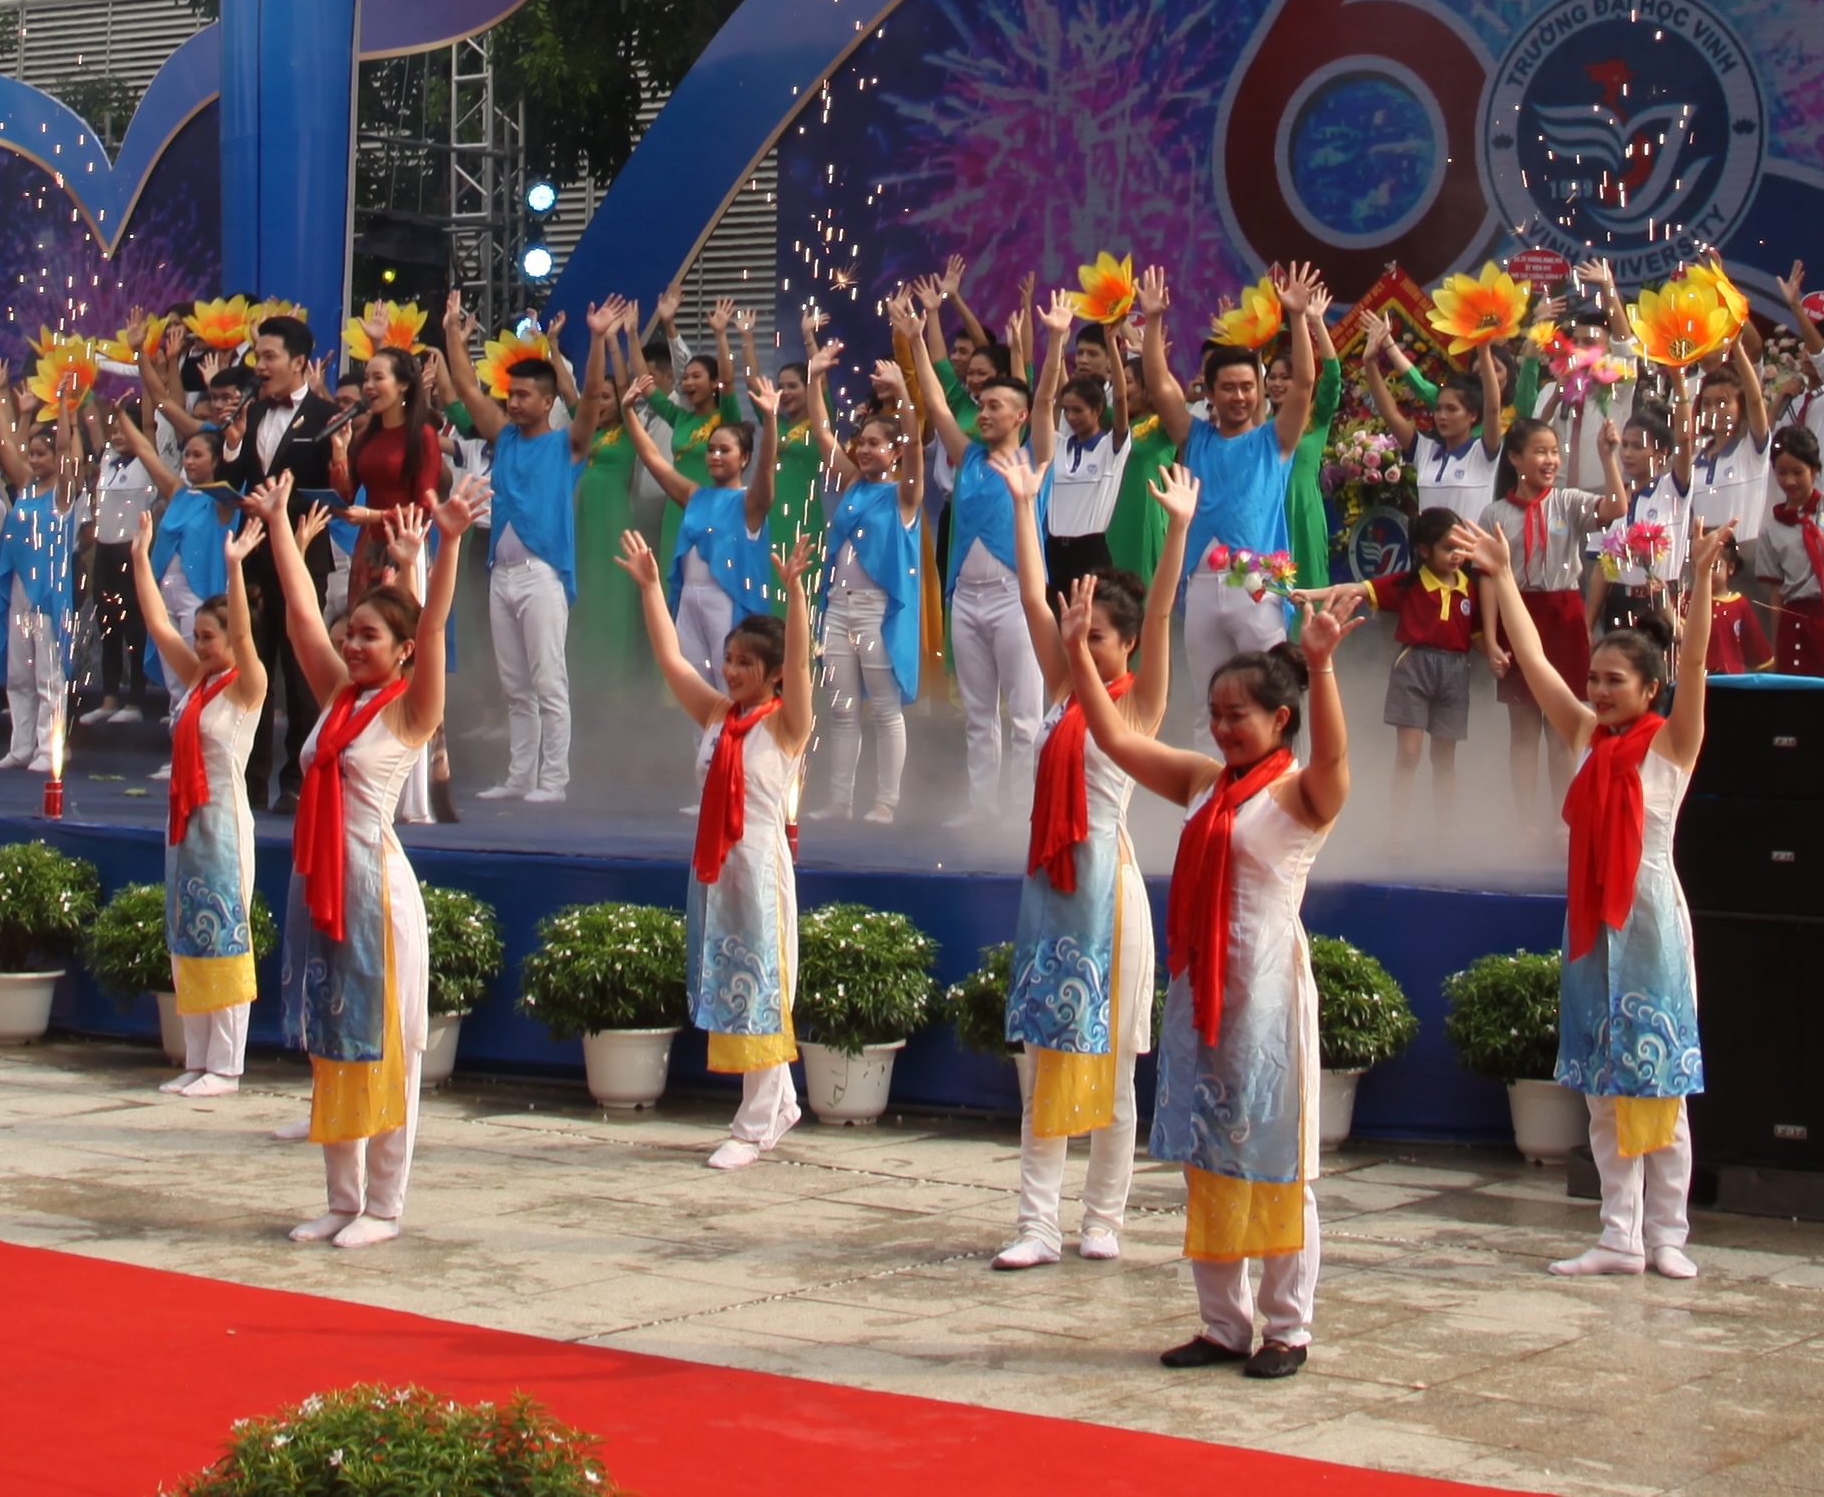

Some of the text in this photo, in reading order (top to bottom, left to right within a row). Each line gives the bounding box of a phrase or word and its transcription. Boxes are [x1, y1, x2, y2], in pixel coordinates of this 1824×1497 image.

[1506, 4, 1588, 88] TRƯỜNG
[1692, 19, 1738, 76] VINH
[1527, 203, 1726, 279] VINH NIVERSITY
